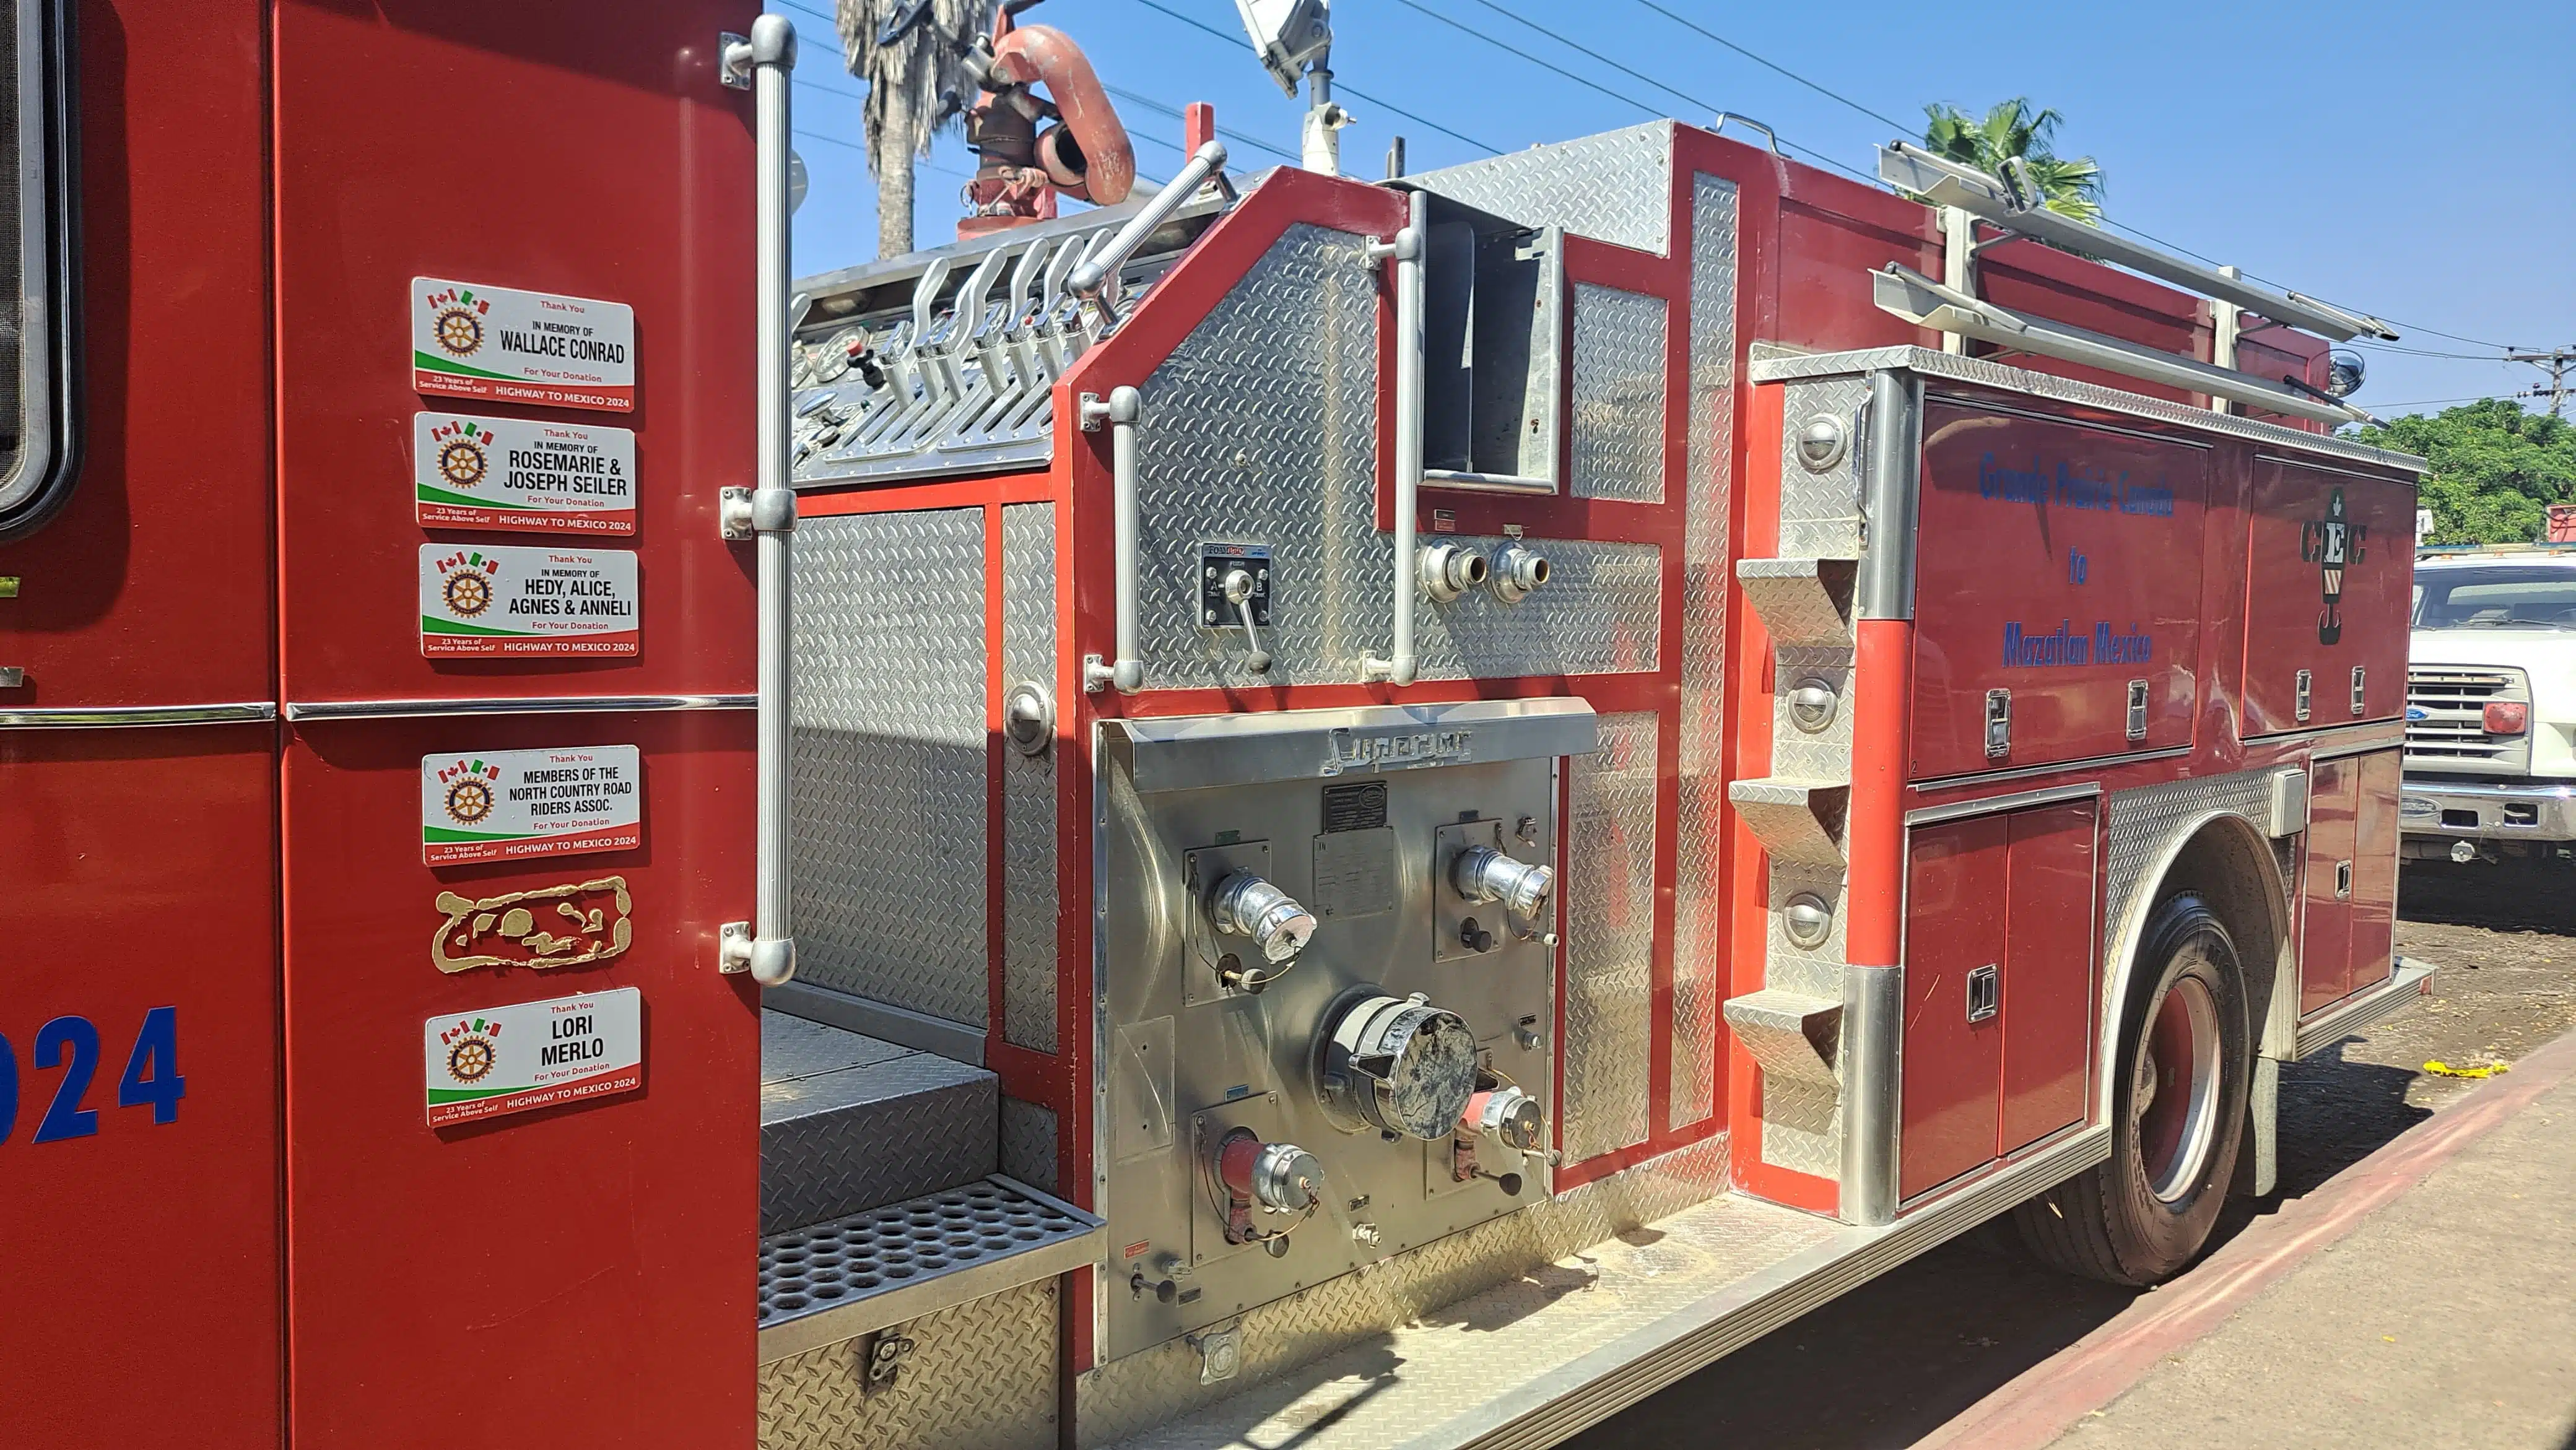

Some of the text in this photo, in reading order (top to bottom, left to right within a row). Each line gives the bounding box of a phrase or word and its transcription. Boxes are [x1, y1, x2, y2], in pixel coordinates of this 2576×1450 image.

[541, 301, 585, 313] Thank You
[533, 321, 593, 336] IN MEMORY OF
[500, 330, 565, 357] WALLACE
[570, 340, 624, 363] CONRAD
[443, 377, 464, 385] Years
[524, 367, 602, 382] For Your Donation
[419, 381, 445, 389] Service
[495, 386, 629, 407] HIGHWAY TO MEXICO 2024
[544, 429, 588, 440] Thank You
[534, 441, 598, 453] IN MEMORY OF
[510, 451, 620, 475] ROSEMARIE &
[504, 471, 627, 495] JOSEPH SEILER
[1980, 451, 2174, 518] Grande Prairie Canada
[544, 497, 564, 506] Your
[567, 499, 604, 507] Donation
[451, 514, 474, 523] Above
[499, 515, 631, 531] HIGHWAY TO MEXICO 2024
[2300, 521, 2368, 566] CEC
[2069, 545, 2087, 584] to
[525, 579, 616, 599] HEDY, ALICE,
[1211, 582, 1217, 590] A
[1256, 582, 1262, 591] B
[509, 599, 630, 615] AGNES & ANNELI
[504, 643, 552, 651] HIGHWAY
[2003, 619, 2152, 667] Mazatlan Mexico
[524, 767, 619, 784] MEMBERS OF THE
[510, 782, 632, 801] NORTH COUNTRY ROAD
[531, 799, 612, 816] RIDERS ASSOC.
[534, 818, 609, 830] For Your Donation
[506, 844, 554, 854] HIGHWAY
[573, 838, 612, 849] MEXICO
[614, 836, 636, 845] 2024
[551, 1002, 594, 1014] Thank You
[552, 1015, 593, 1040] LORI
[542, 1038, 604, 1066] MERLO
[0, 1005, 185, 1147] 24
[534, 1062, 609, 1082] For Your Donation
[507, 1078, 635, 1108] HIGHWAY TO MEXICO 2024
[433, 1105, 498, 1122] Service Above Self
[457, 1103, 476, 1112] Years
